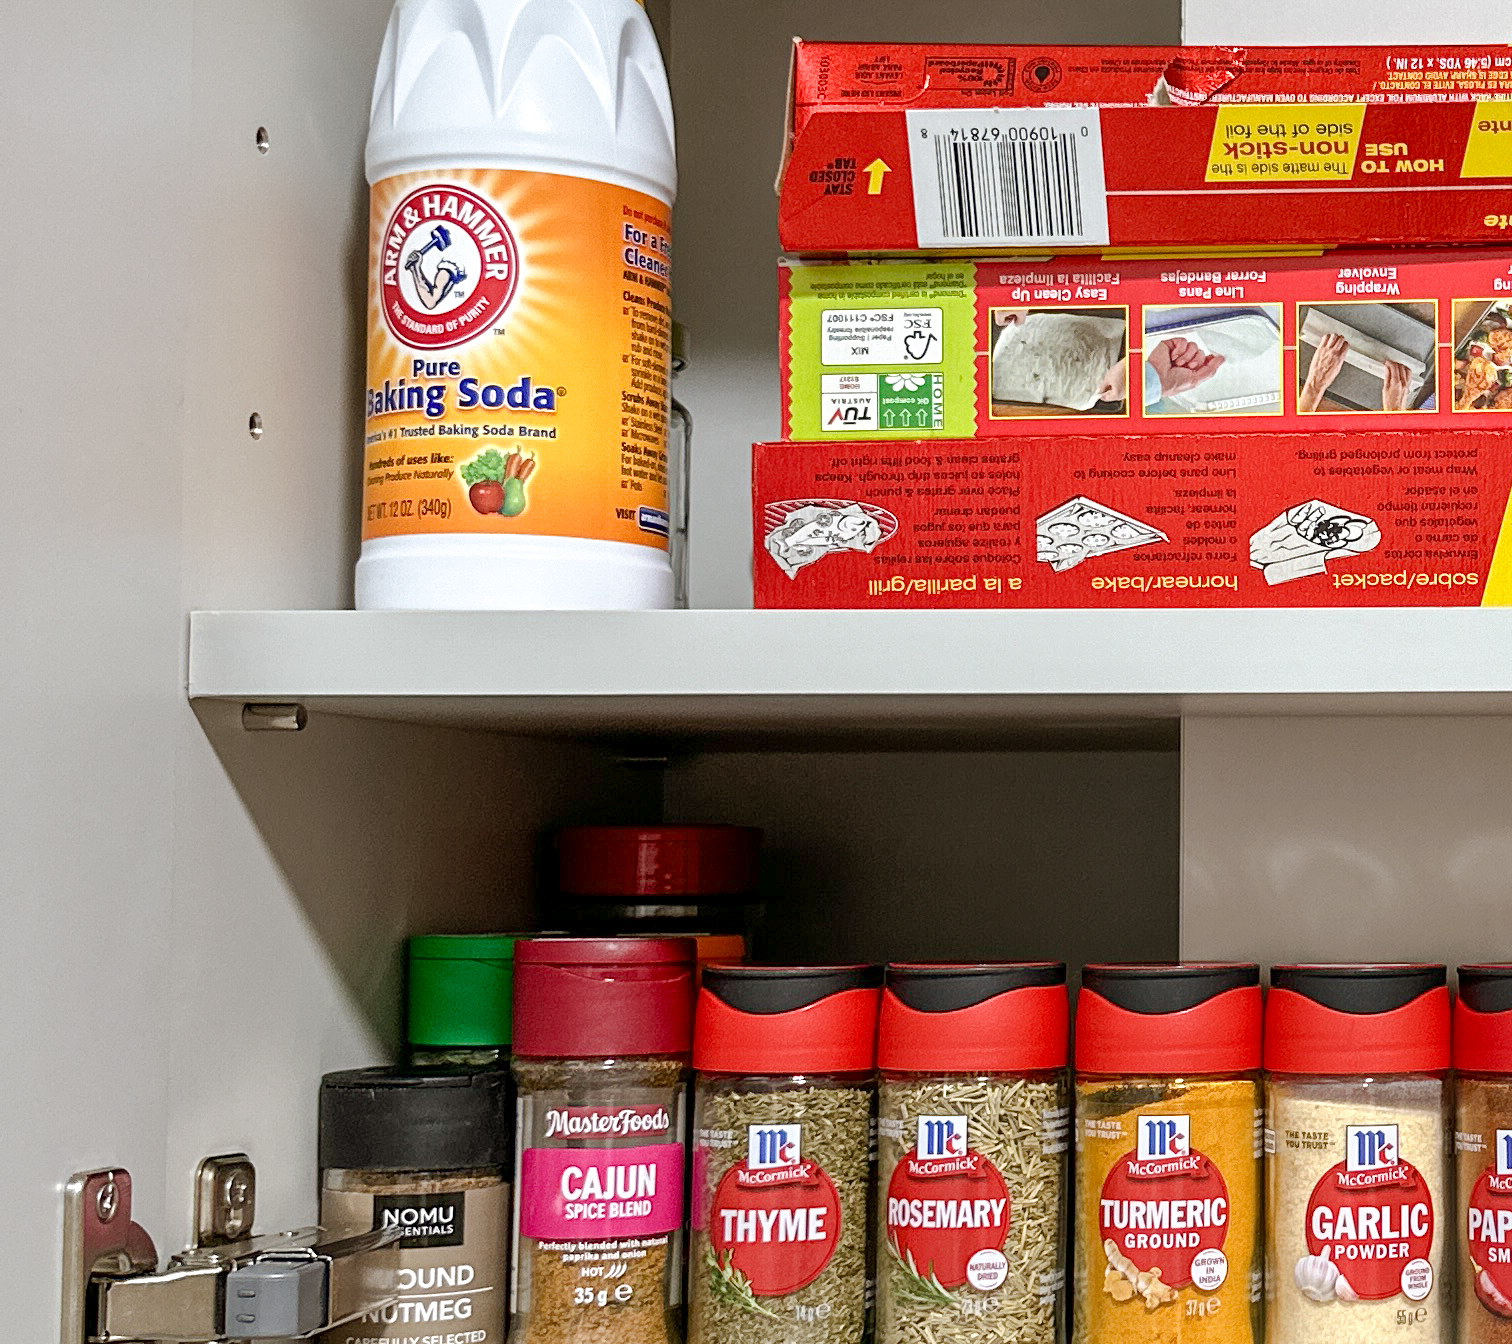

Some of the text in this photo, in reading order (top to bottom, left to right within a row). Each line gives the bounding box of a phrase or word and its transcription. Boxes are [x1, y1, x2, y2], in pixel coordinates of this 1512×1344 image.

[950, 127, 1058, 143] 10900 67814
[1224, 141, 1350, 159] non-stick
[1365, 143, 1409, 156] USE
[1361, 160, 1444, 174] HOW TO
[385, 195, 508, 286] ARM & HAMMER
[1160, 270, 1267, 285] Forrar Bandejas
[1338, 266, 1397, 281] Envolver
[1179, 285, 1245, 299] Line Pans
[1336, 281, 1400, 295] Wrapping
[392, 296, 490, 334] THE STANDARD OF PURITY
[413, 359, 460, 377] Pure
[400, 424, 556, 438] Trusted Baking Soda Brand
[868, 576, 1022, 595] a la parilla/grill
[1092, 572, 1238, 592] hornear/bake
[1332, 572, 1478, 589] sobre/packet
[545, 1108, 669, 1137] MasterFoods
[738, 1164, 809, 1184] McCormick
[909, 1157, 975, 1174] McCormick
[1128, 1157, 1197, 1174] McCormick
[561, 1164, 656, 1200] CAJUN
[1337, 1167, 1406, 1185] McCormick
[383, 1206, 454, 1228] NOMU
[565, 1201, 651, 1219] SPICE BLEND
[888, 1198, 1006, 1228] ROSEMARY
[1101, 1198, 1226, 1228] TURMERIC
[721, 1207, 827, 1242] THYME
[1312, 1203, 1429, 1240] GARLIC
[1124, 1233, 1200, 1248] GROUND
[1334, 1243, 1409, 1260] POWDER
[582, 1267, 604, 1277] HOT
[574, 1288, 607, 1306] 35 g
